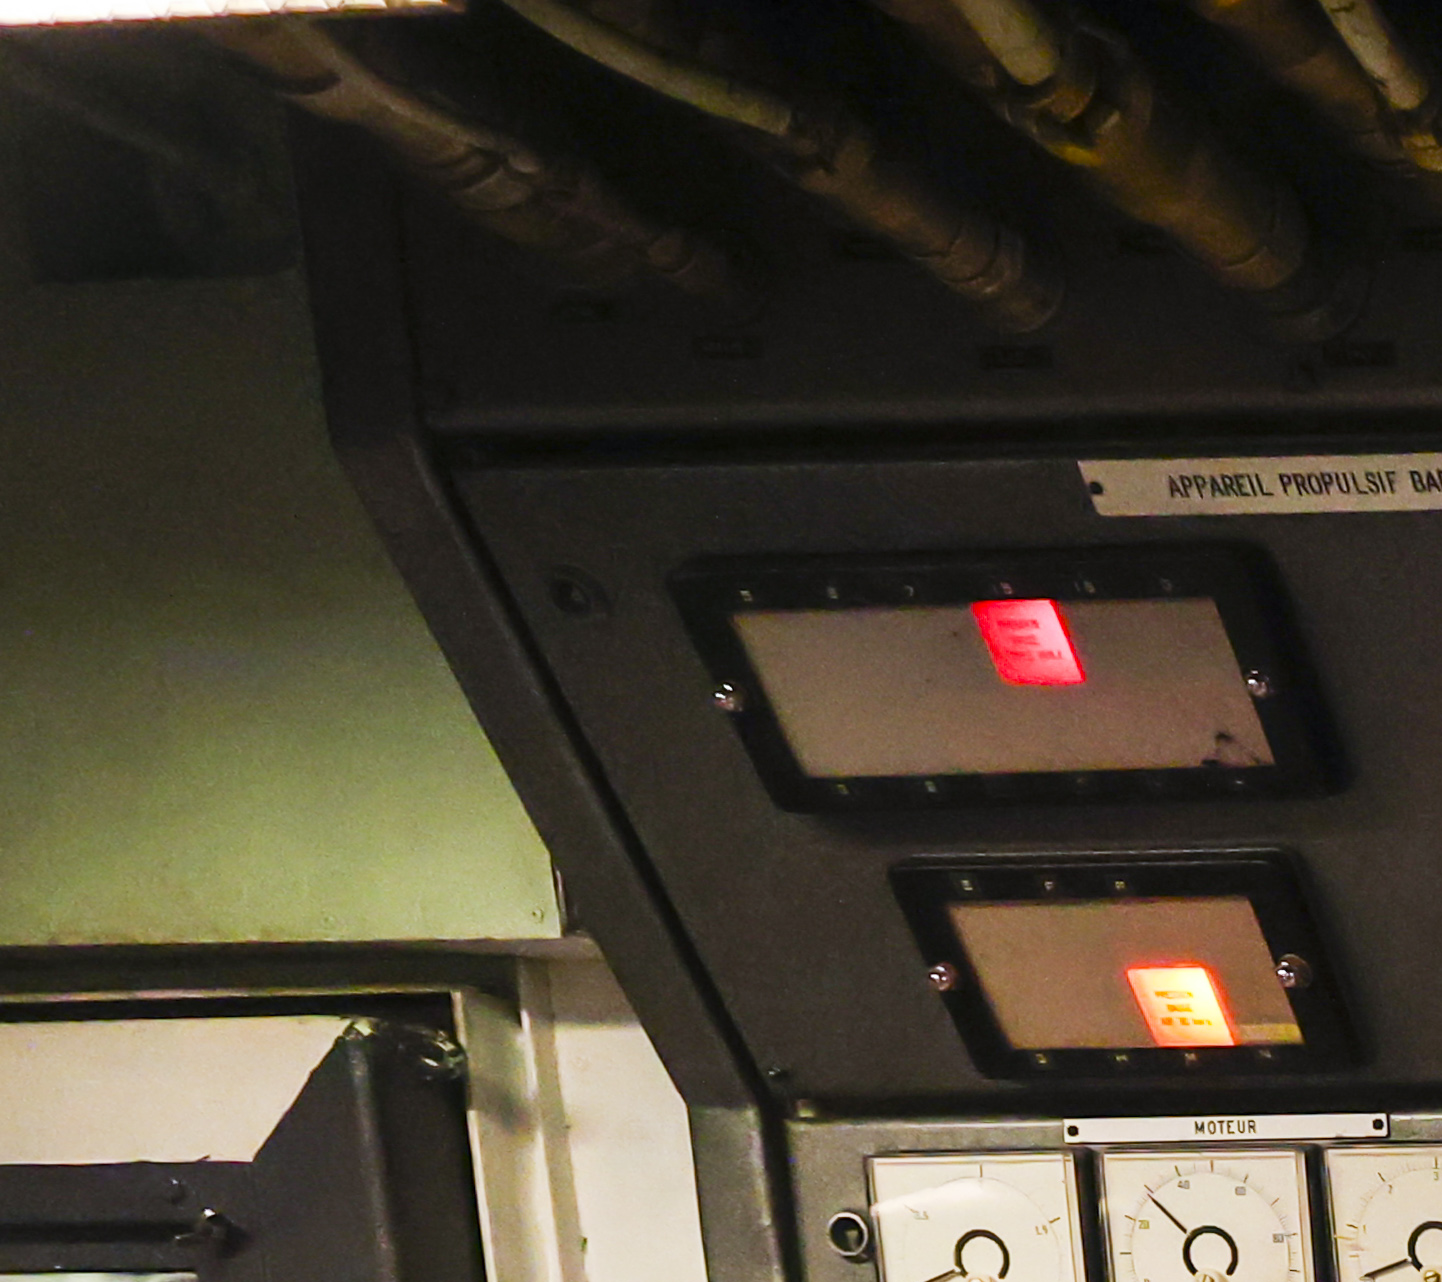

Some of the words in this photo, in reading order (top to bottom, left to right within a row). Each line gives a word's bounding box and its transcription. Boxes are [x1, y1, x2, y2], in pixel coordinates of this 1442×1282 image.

[1167, 474, 1274, 500] APPAREIL
[1280, 471, 1398, 498] PROPULSIF
[1194, 1120, 1257, 1135] MOTEUR
